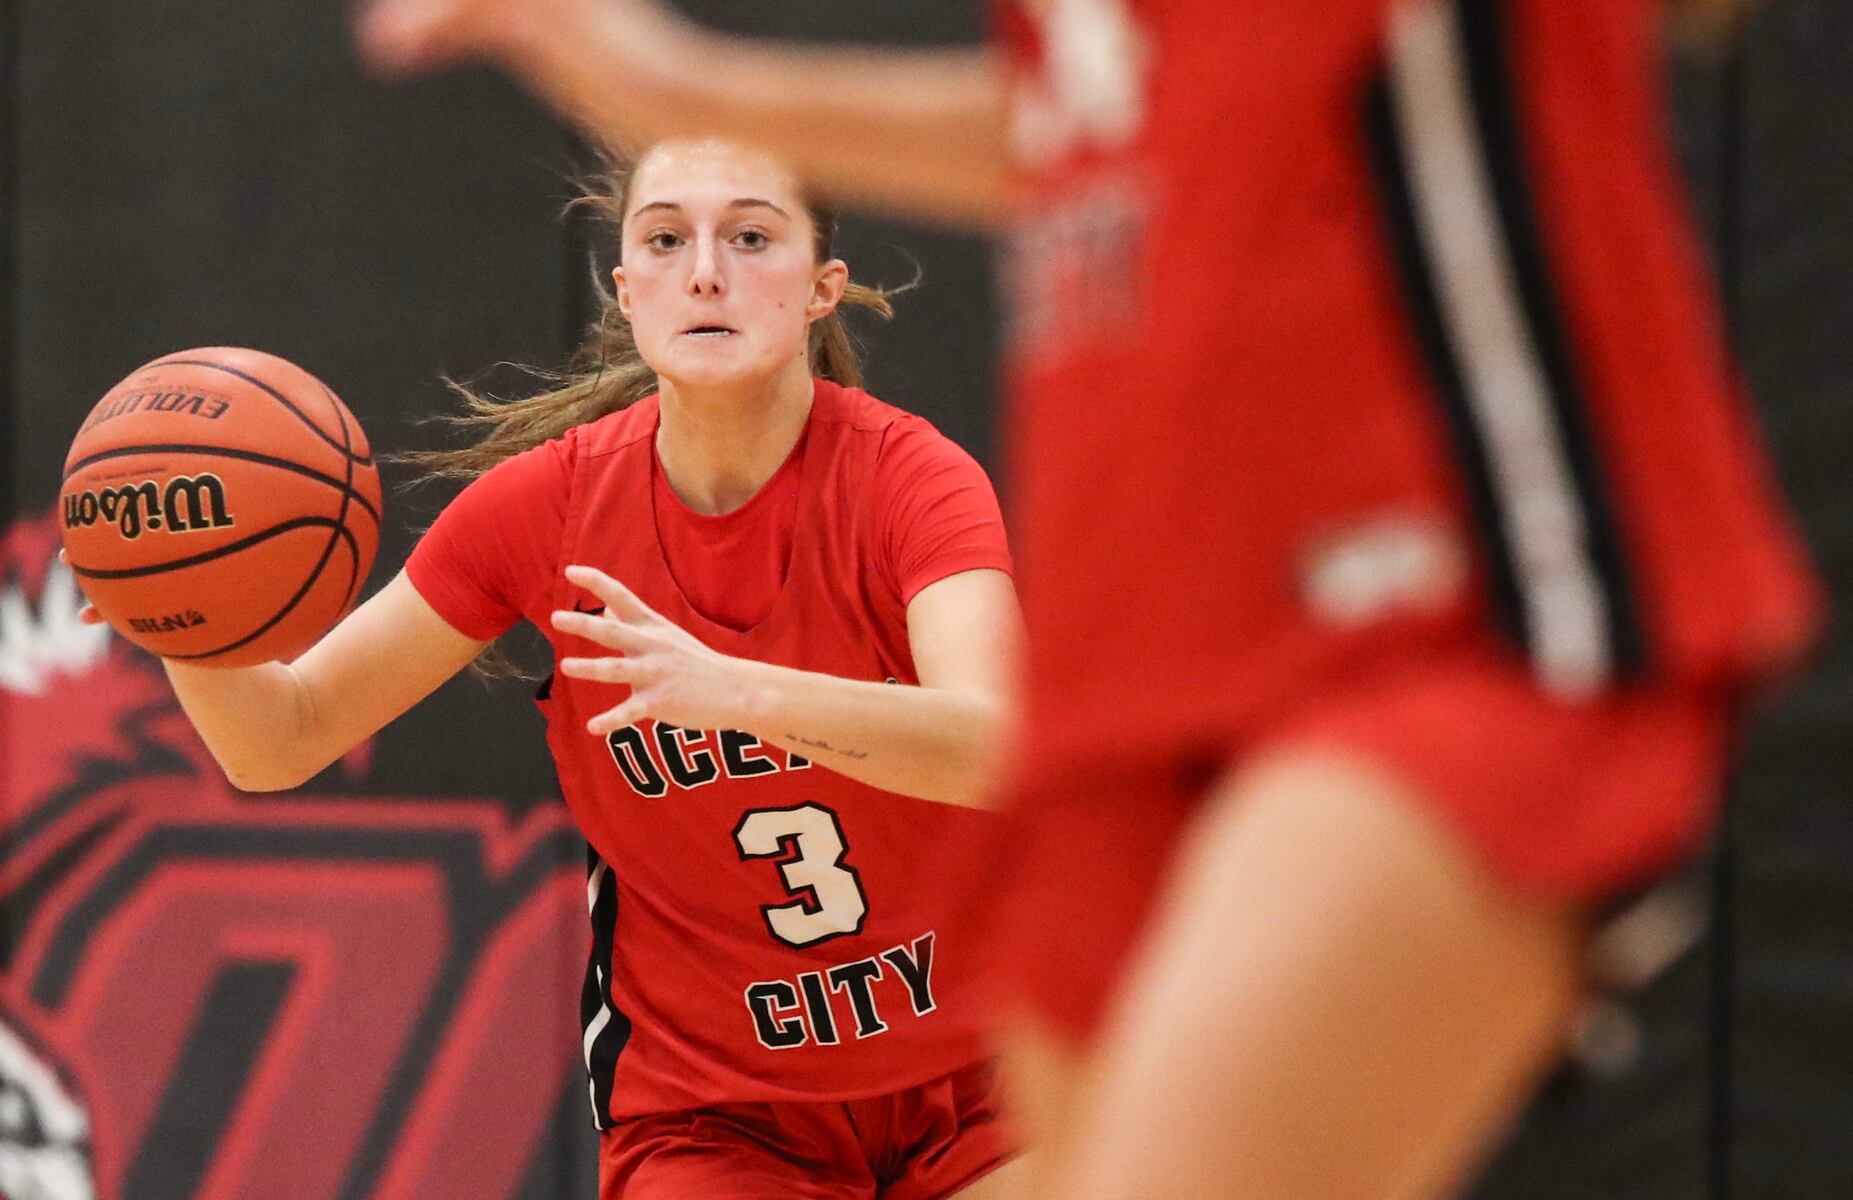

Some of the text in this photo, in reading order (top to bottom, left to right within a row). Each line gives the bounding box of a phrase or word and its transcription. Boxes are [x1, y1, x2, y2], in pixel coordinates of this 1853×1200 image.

[81, 391, 230, 434] EVOLUT
[64, 472, 235, 540] Wilson
[607, 720, 814, 797] OCE
[732, 801, 869, 949] 3
[745, 932, 936, 1049] CITY
